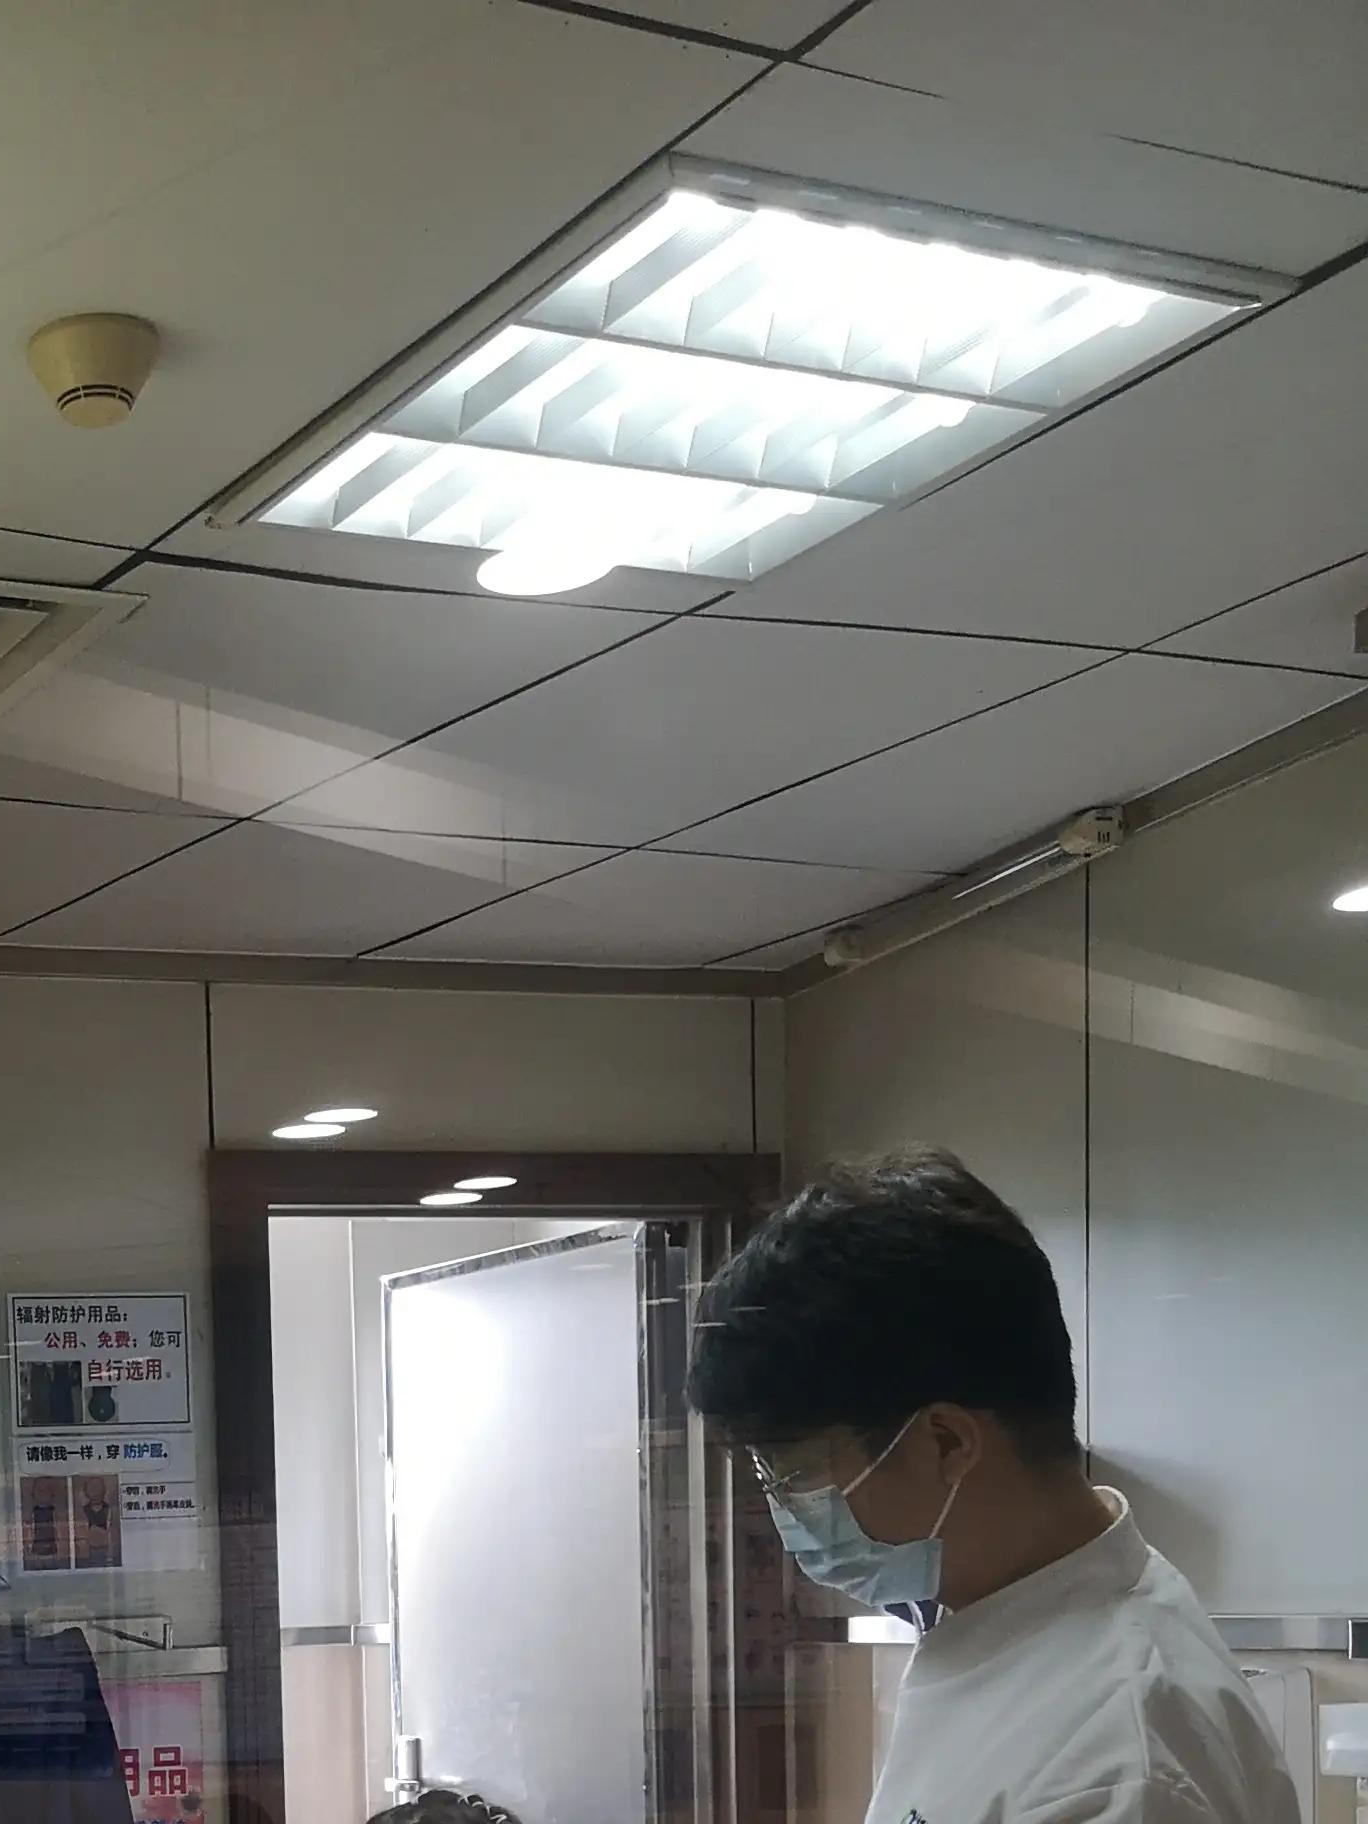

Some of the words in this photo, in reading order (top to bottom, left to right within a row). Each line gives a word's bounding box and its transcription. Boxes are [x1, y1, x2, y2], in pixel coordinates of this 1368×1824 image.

[16, 1305, 128, 1324] 辐射防护用品：
